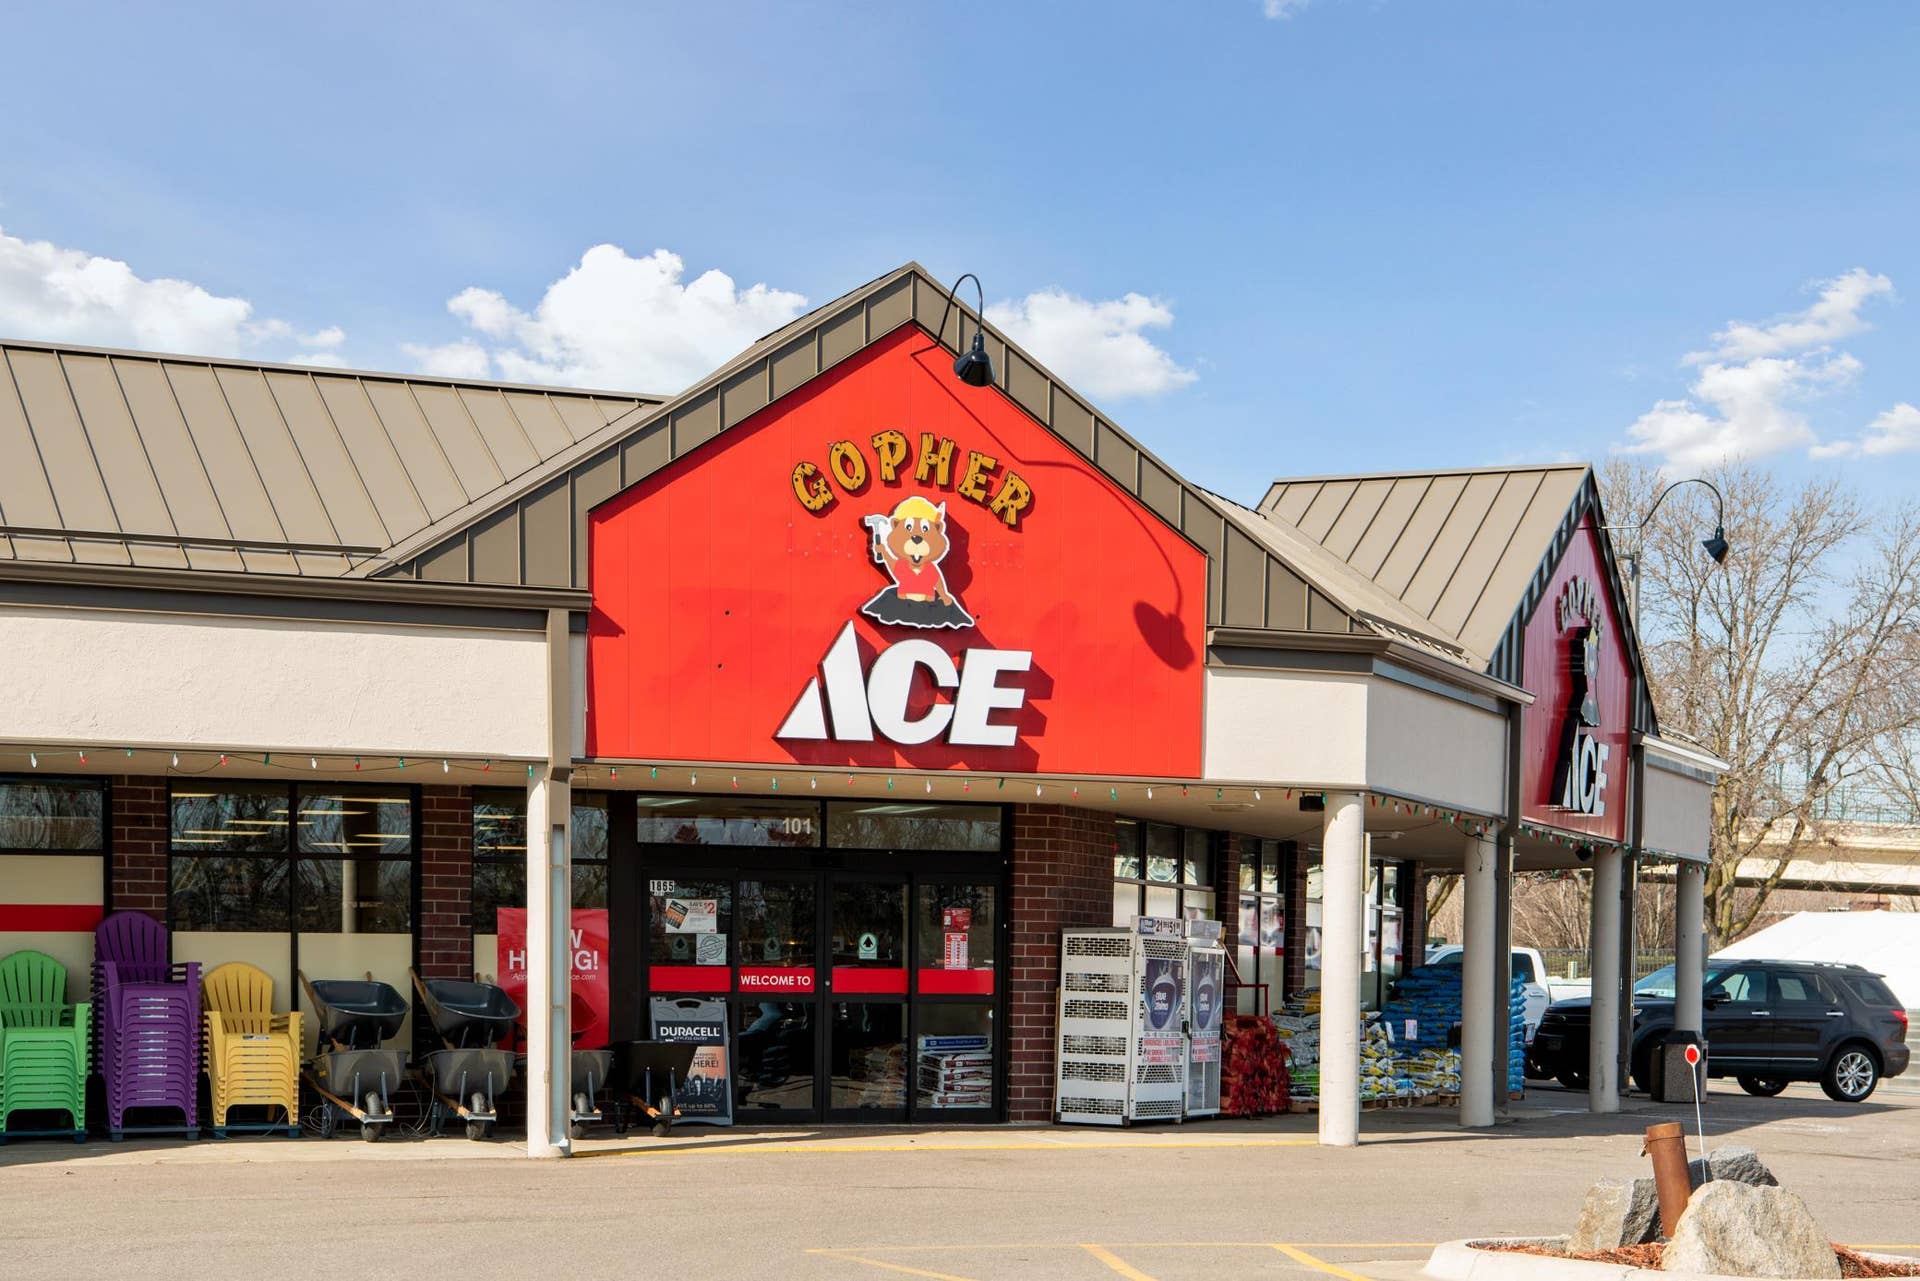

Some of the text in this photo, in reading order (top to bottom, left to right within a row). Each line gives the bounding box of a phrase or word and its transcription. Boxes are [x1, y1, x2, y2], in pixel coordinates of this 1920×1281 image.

[791, 430, 1031, 525] GOPHER
[775, 619, 1033, 746] ACE
[1563, 720, 1610, 817] ACE
[783, 817, 811, 834] 101
[650, 880, 674, 892] 1865
[740, 975, 811, 986] WELCOME TO
[660, 1026, 720, 1037] DURACELL
[692, 1060, 719, 1068] HERE!
